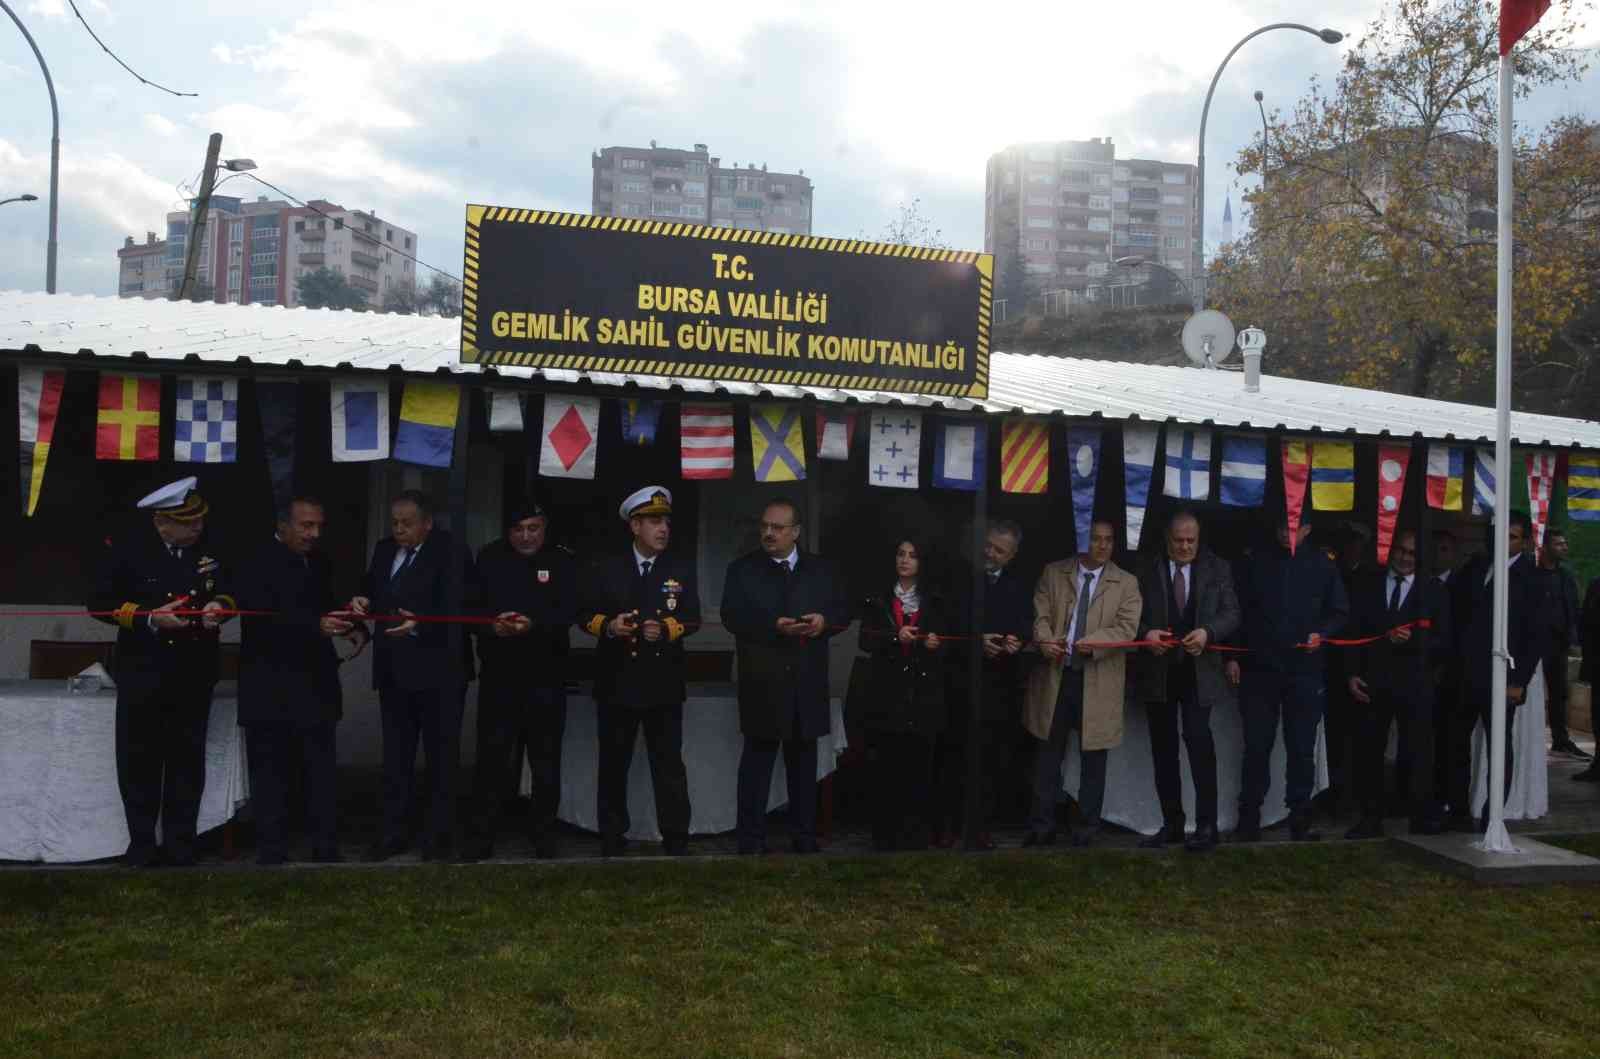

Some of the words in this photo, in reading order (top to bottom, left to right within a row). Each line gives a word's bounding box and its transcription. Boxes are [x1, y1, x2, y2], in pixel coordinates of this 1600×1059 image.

[711, 253, 754, 281] T.C.
[638, 284, 720, 315] BURSA
[727, 289, 827, 324] VALİLİĞİ
[491, 308, 589, 343] GEMLİK
[596, 316, 670, 348] SAHİL
[677, 320, 801, 358] GÜVENLİK
[807, 334, 965, 371] KOMUTANLIĞI
